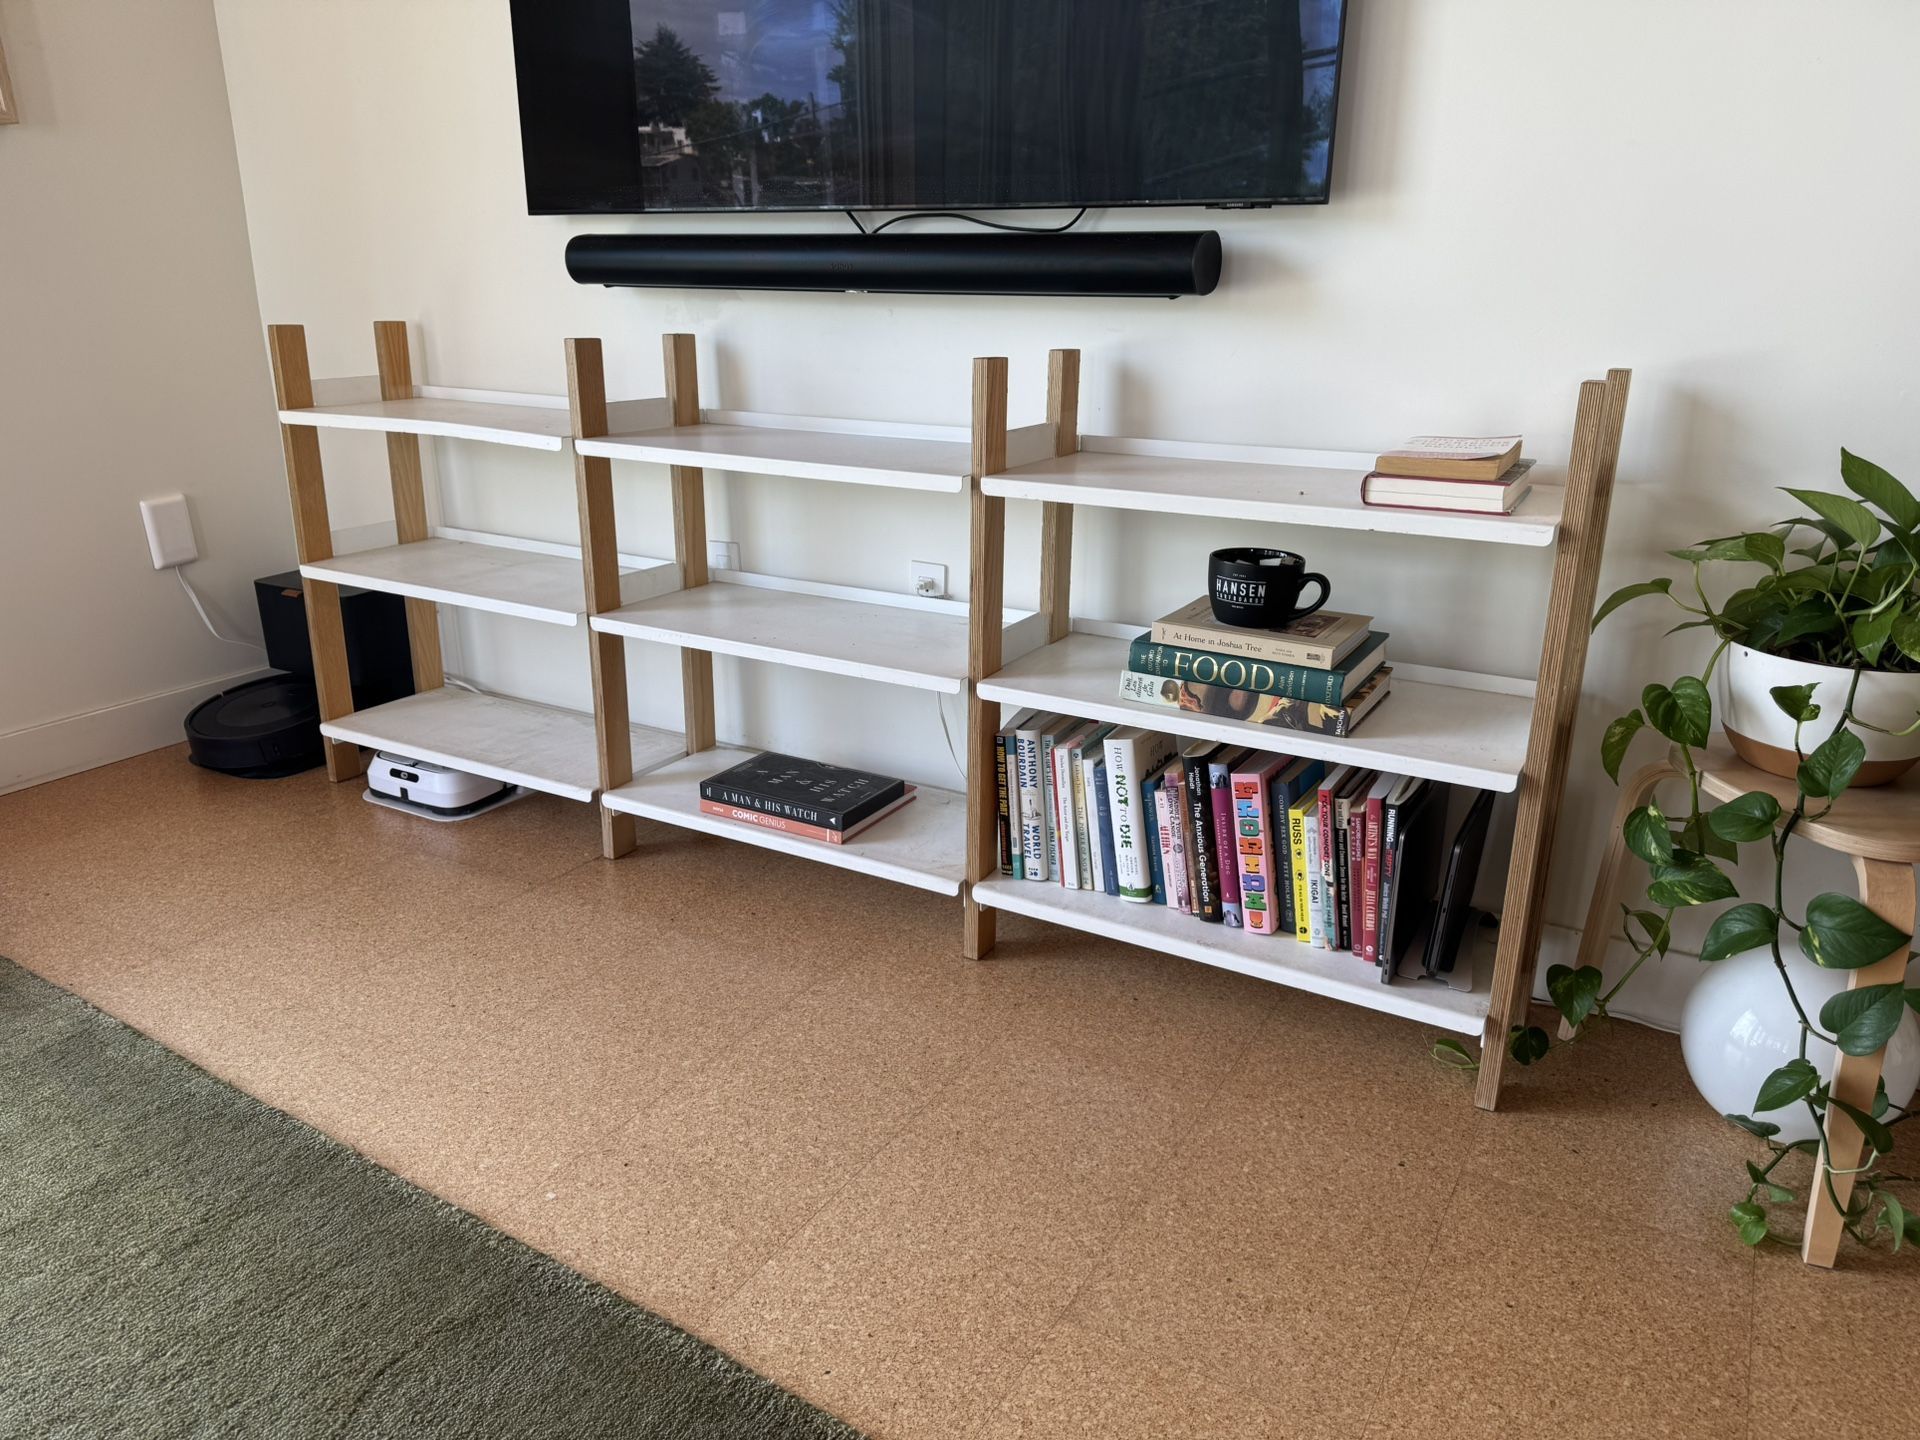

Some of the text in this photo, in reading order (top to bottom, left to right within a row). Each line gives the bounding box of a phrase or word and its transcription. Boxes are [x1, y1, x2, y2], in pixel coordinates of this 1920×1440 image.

[1216, 578, 1266, 597] HANSEN
[1216, 592, 1264, 604] SURFBOARDS
[1173, 632, 1183, 641] At
[1184, 634, 1206, 644] Home
[1216, 639, 1243, 649] Joshua
[1244, 643, 1263, 653] Tree
[1146, 649, 1156, 671] OXFORD
[1162, 659, 1168, 667] TO
[1173, 652, 1274, 691] FOOD
[1147, 681, 1156, 697] Gala
[1335, 709, 1345, 736] TASCHEN
[996, 746, 1004, 763] HOW
[1017, 738, 1028, 789] BOURDAIN
[1027, 739, 1038, 789] ANTHONY
[1114, 747, 1124, 772] HOW
[997, 764, 1005, 772] TO
[998, 773, 1006, 786] GET
[809, 779, 837, 793] HIS
[820, 778, 870, 802] WATCH
[999, 787, 1007, 797] THE
[1116, 775, 1129, 807] NOT
[1194, 766, 1202, 796] Jonathan
[721, 791, 818, 822] A MAN & HIS WATCH
[999, 799, 1008, 816] PART
[1120, 808, 1128, 823] TO
[1278, 794, 1286, 824] COMEDY
[731, 809, 759, 823] COMIC
[759, 815, 787, 829] GENIUS
[1321, 810, 1329, 828] YOUR
[1386, 808, 1396, 842] RUNNING
[1023, 823, 1032, 860] TRAVEL
[1032, 825, 1041, 860] WORLD
[1048, 825, 1056, 843] JENNA
[1121, 825, 1134, 848] DIE
[1291, 818, 1302, 845] RUSS
[1367, 821, 1379, 846] ARTIST'S
[1049, 843, 1057, 865] FISCHER
[1193, 802, 1210, 902] The Anxious Generation
[1321, 829, 1331, 859] COMFORT
[1323, 859, 1331, 877] ZONE
[1384, 849, 1393, 877] EMPTY
[1284, 879, 1292, 907] HOLMES
[1310, 879, 1320, 904] IKIGAI
[1365, 889, 1376, 905] JULIA
[1365, 905, 1376, 931] CAMERON
